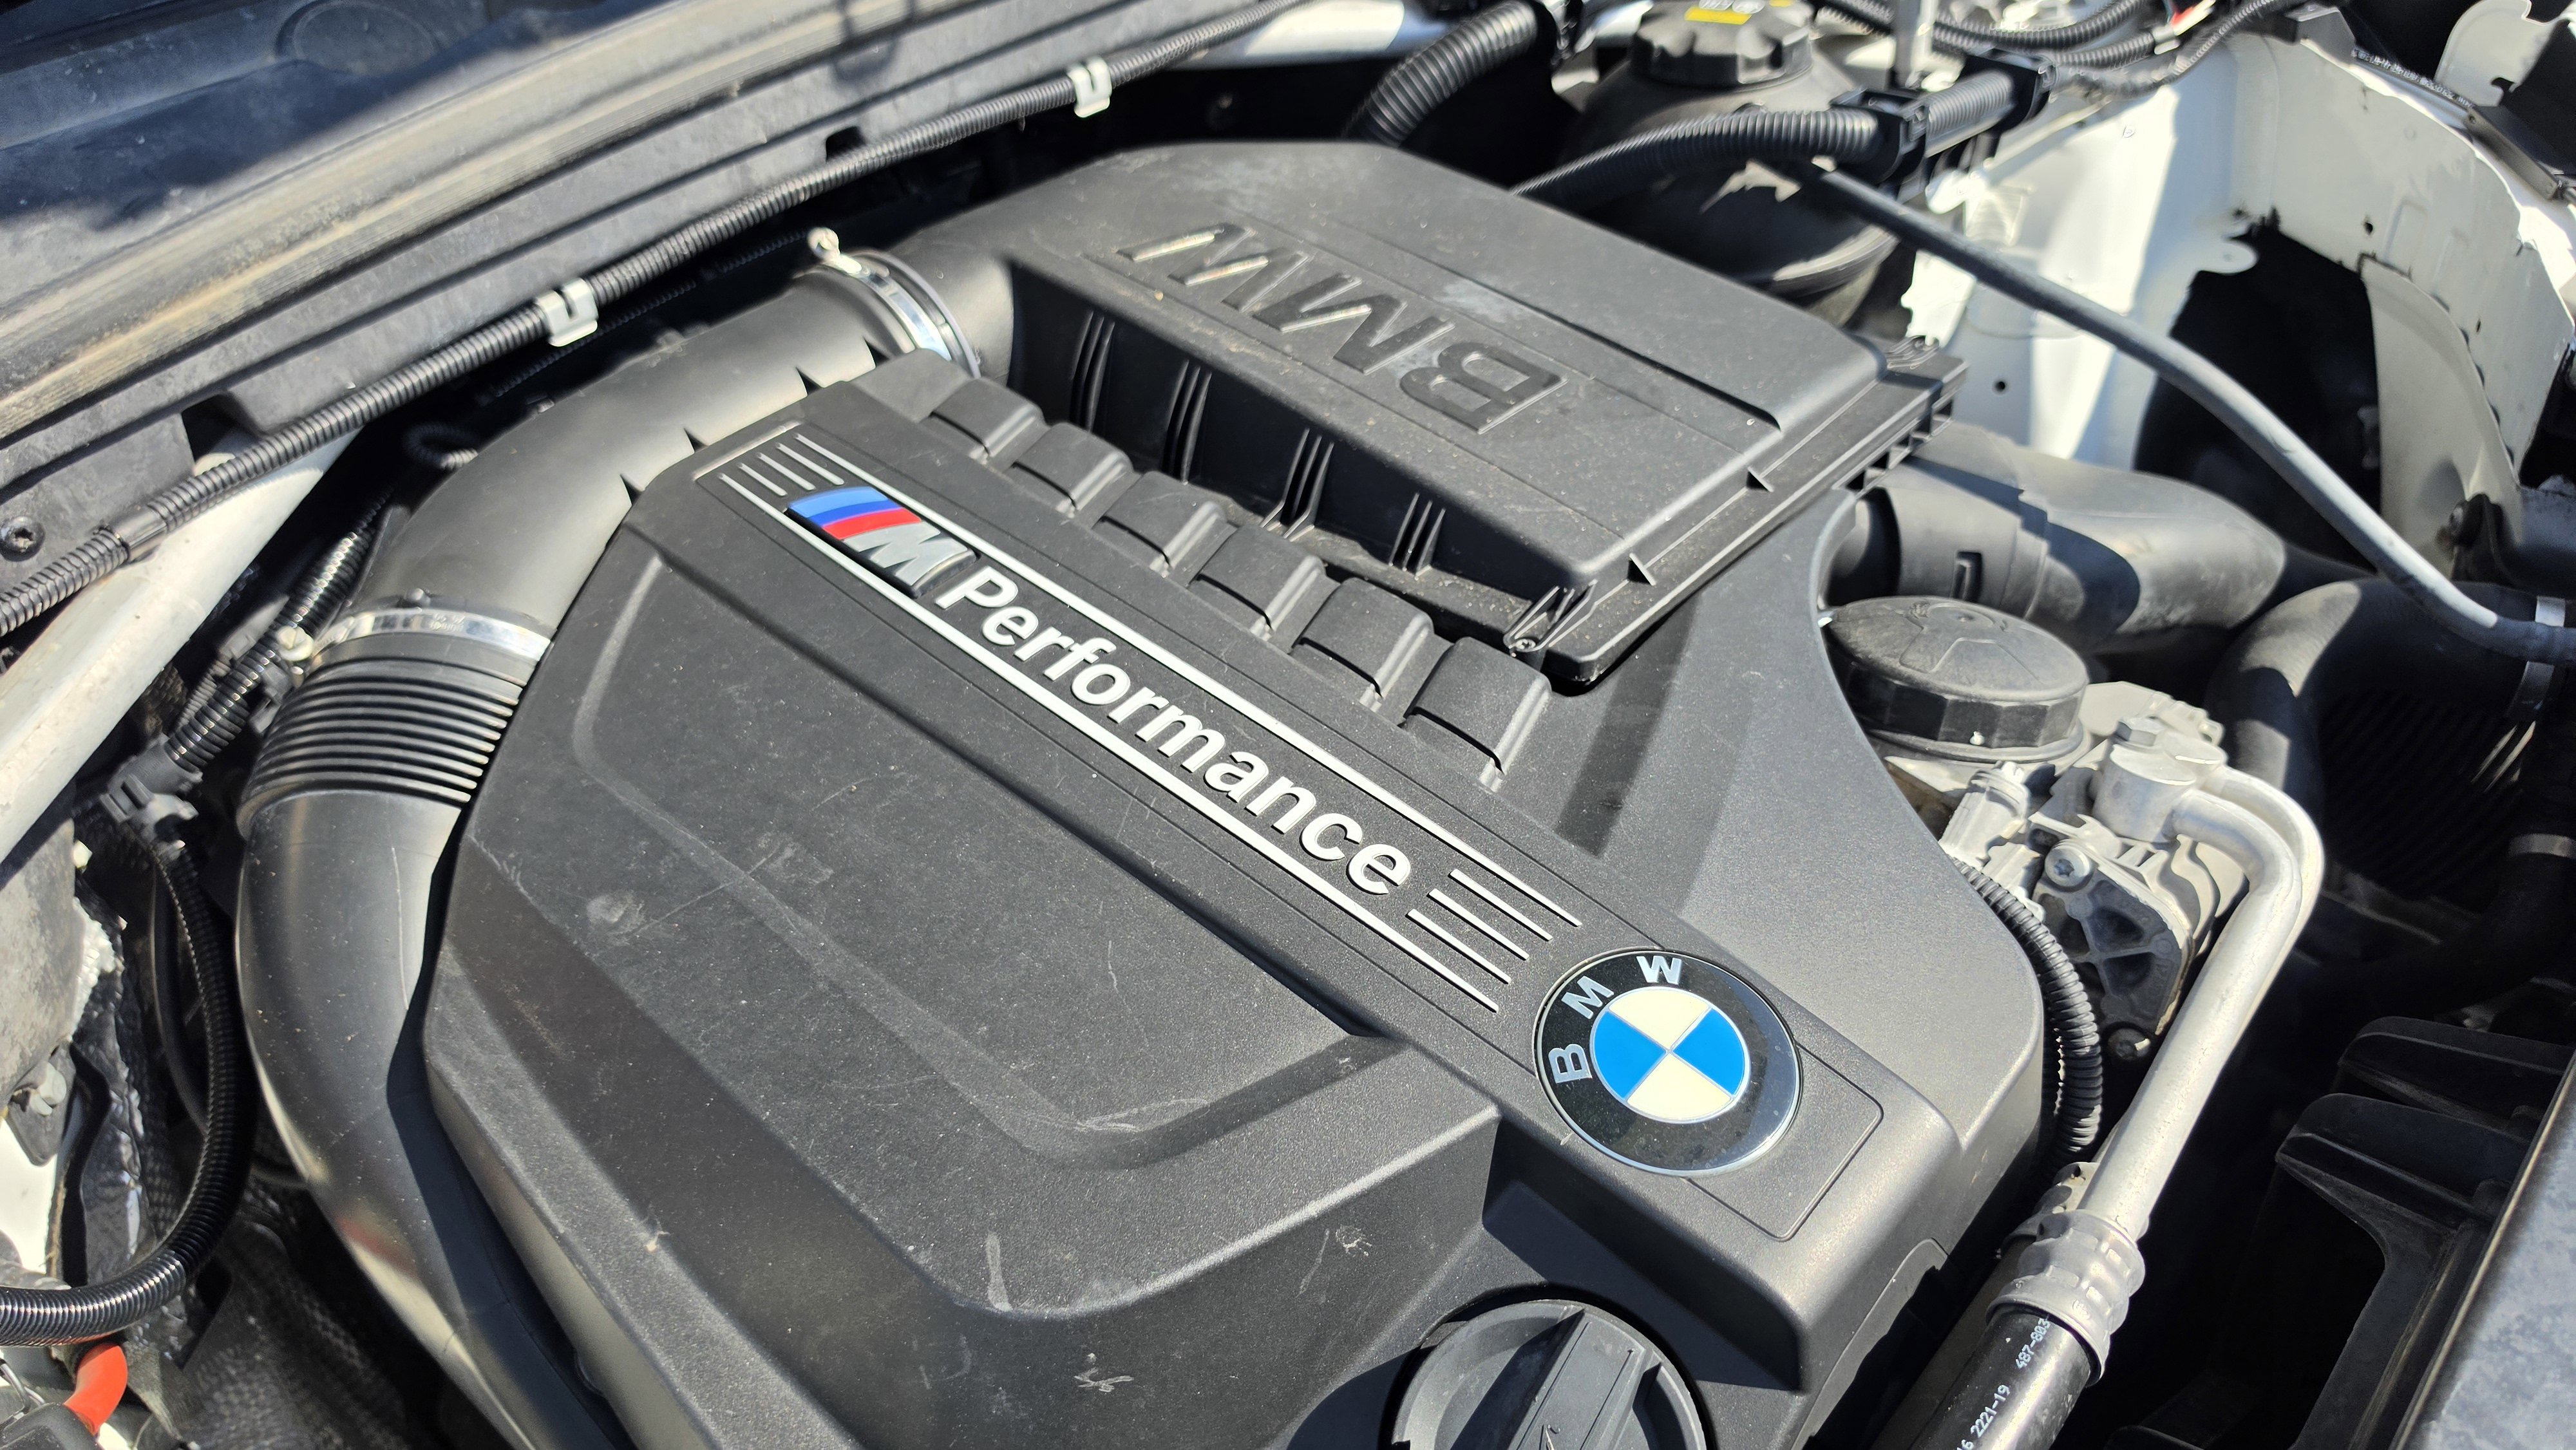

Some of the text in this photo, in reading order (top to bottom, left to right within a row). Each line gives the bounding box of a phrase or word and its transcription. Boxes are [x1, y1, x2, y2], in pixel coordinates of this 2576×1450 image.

[1117, 223, 1568, 434] BMW
[934, 565, 1412, 896] Performance
[1548, 955, 1682, 1084] BMW
[1971, 1384, 2011, 1438] 2221-19
[2016, 1317, 2050, 1370] 487-803
